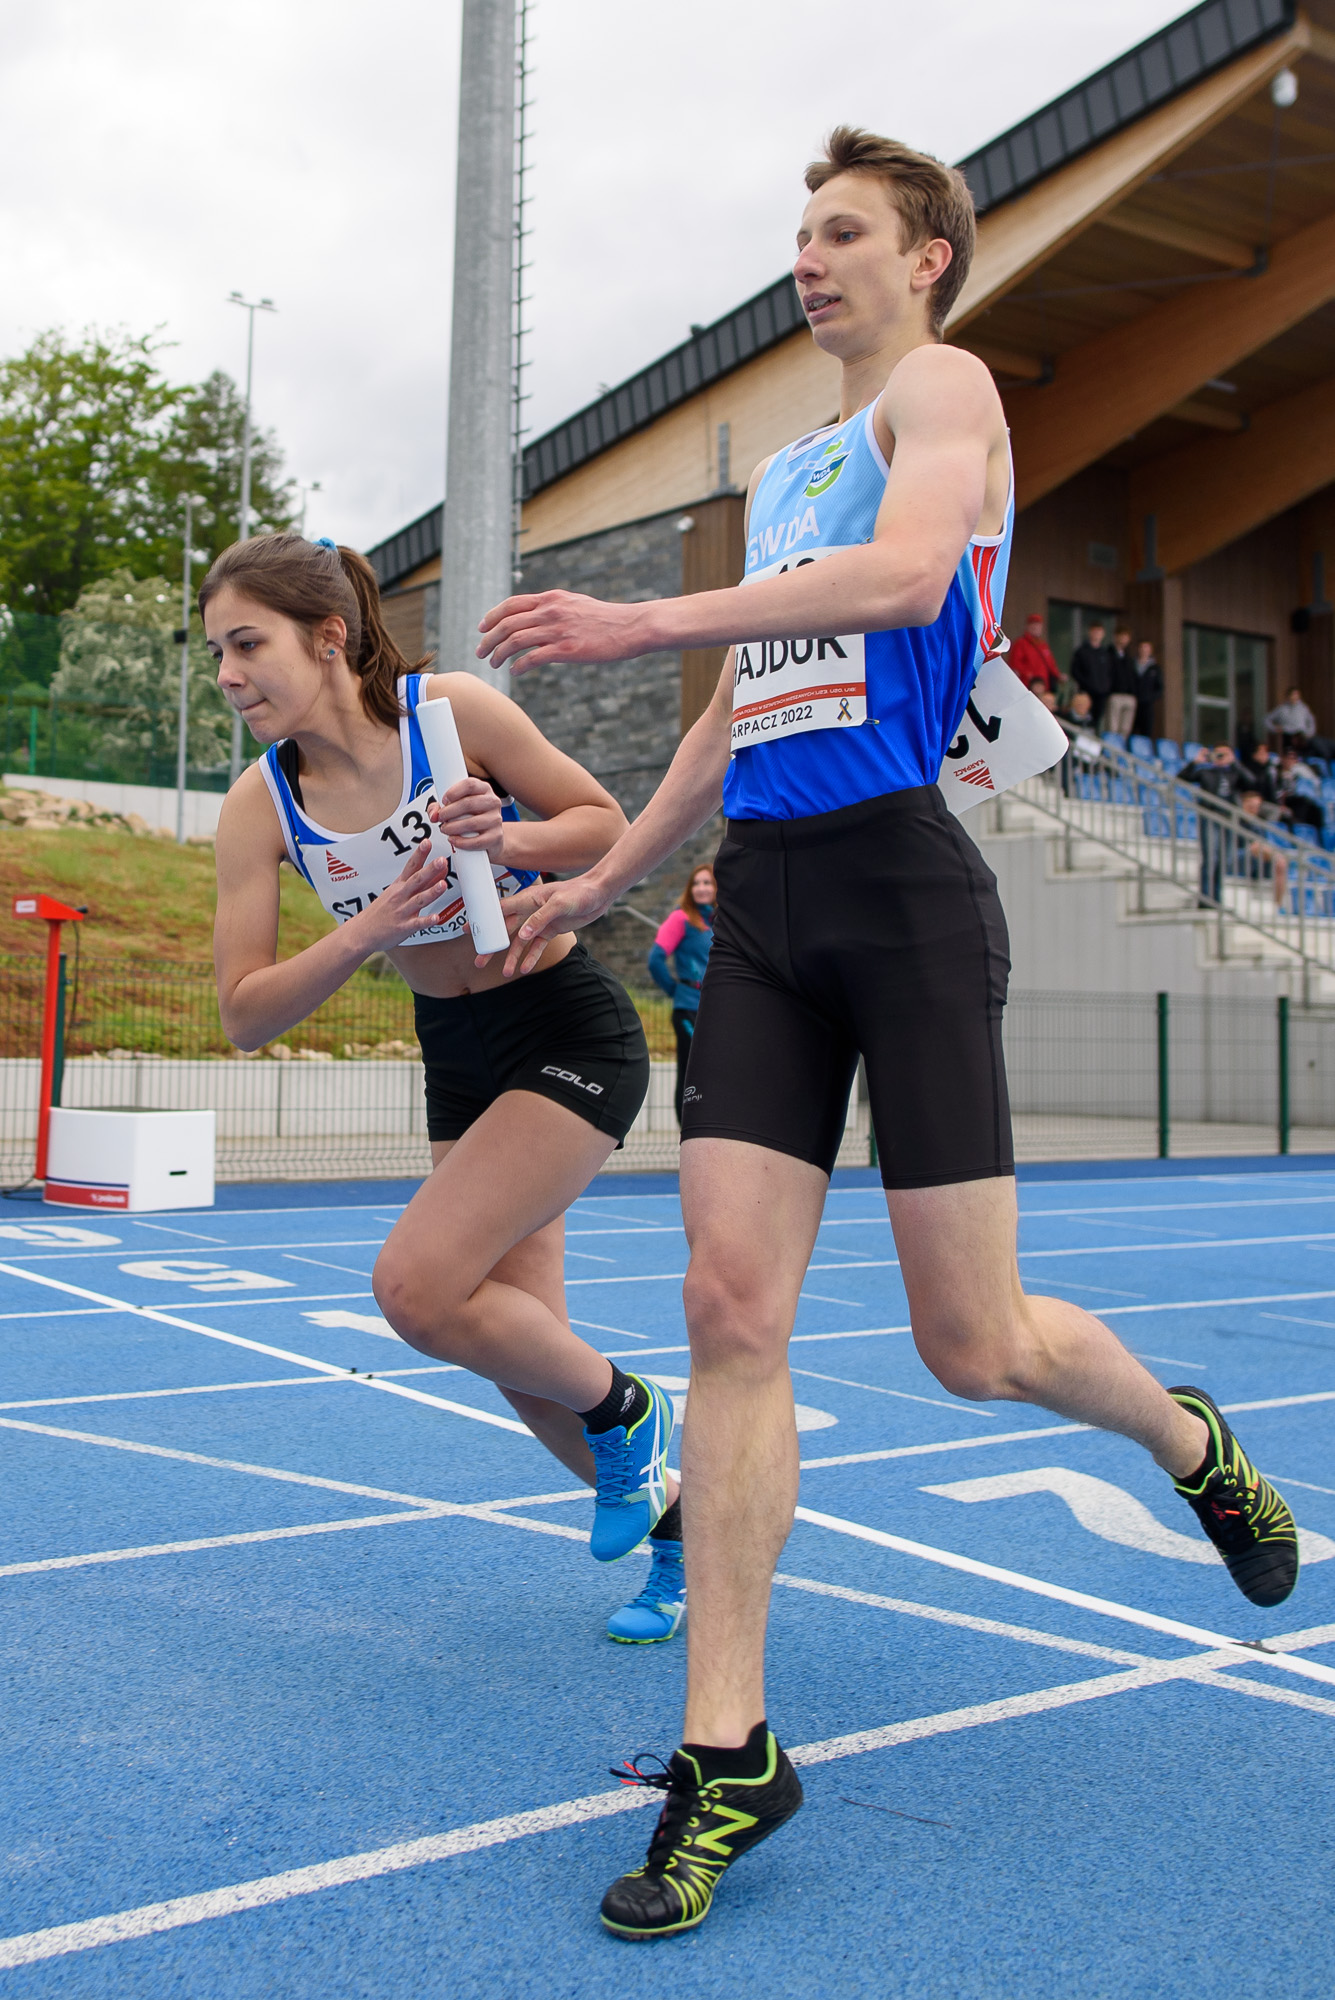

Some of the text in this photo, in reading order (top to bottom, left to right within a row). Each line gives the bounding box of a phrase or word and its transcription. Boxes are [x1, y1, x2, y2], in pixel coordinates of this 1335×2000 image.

[731, 705, 813, 739] ARPACZ 2022
[953, 759, 986, 778] KARPACZ
[330, 871, 359, 882] KARPACZ
[540, 1065, 605, 1095] COLO
